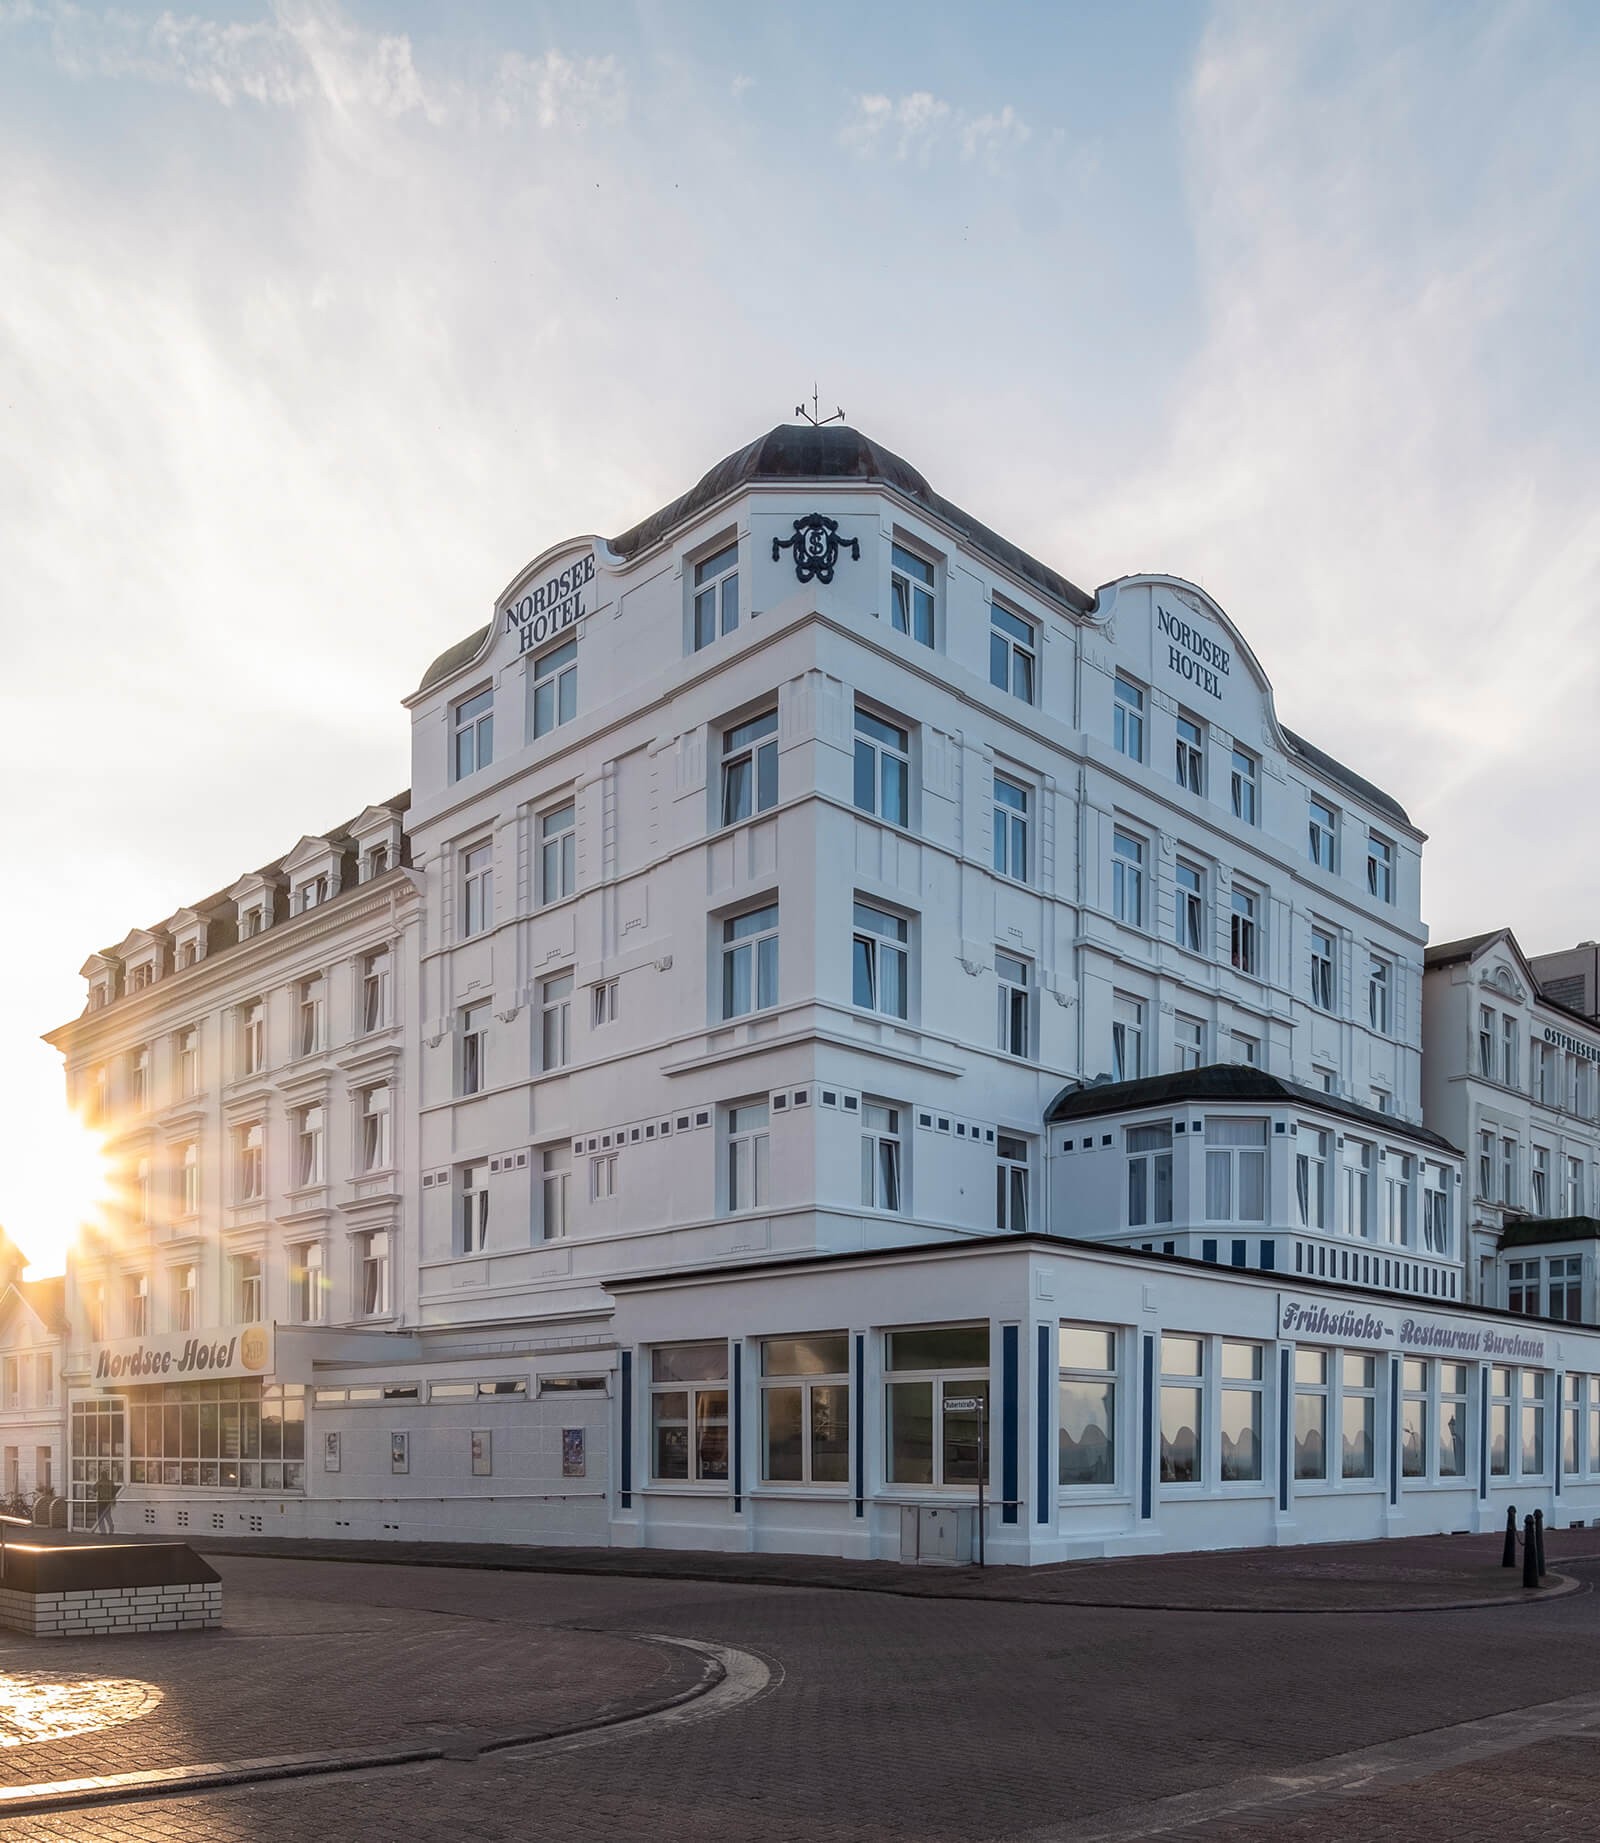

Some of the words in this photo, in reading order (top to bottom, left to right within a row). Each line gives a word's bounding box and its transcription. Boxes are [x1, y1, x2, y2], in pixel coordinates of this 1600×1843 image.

[506, 552, 595, 634] NORDSEE
[519, 592, 586, 654] HOTEL
[1157, 605, 1230, 676] NORDSEE
[1168, 645, 1222, 700] HOTEL
[96, 1336, 238, 1379] Nordsee-Hotel
[1283, 1302, 1394, 1340] Frühstücks-
[1400, 1319, 1480, 1351] Restaurant
[1483, 1330, 1544, 1359] Burchana
